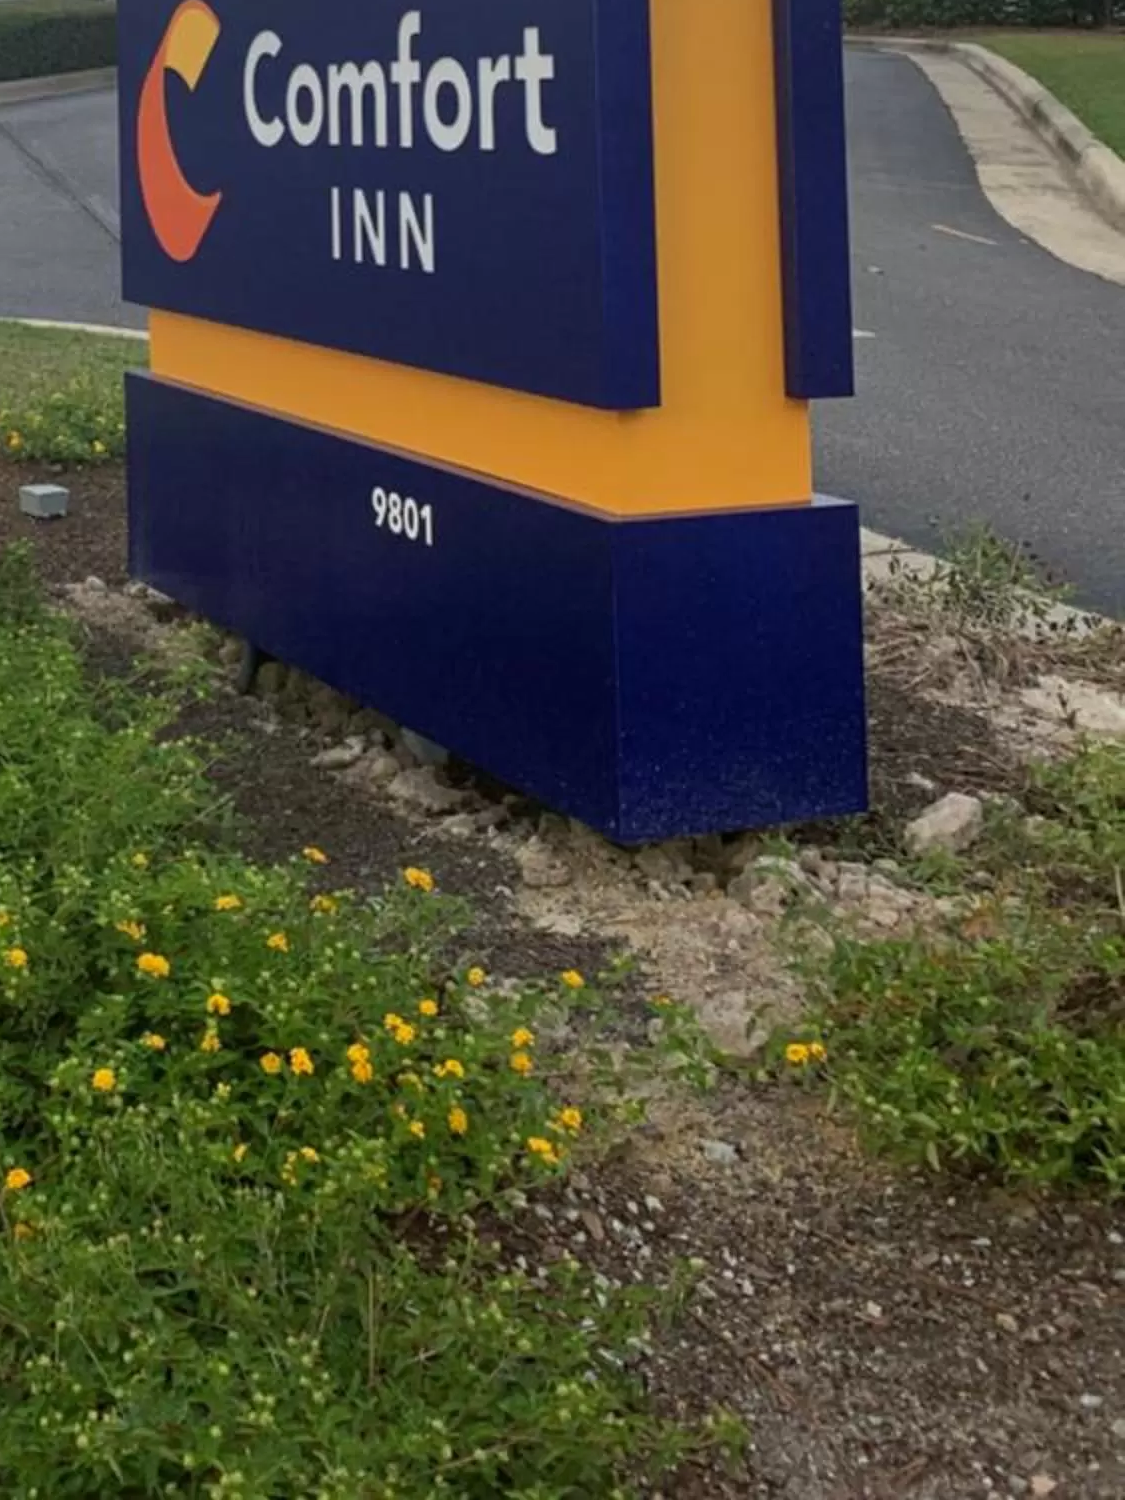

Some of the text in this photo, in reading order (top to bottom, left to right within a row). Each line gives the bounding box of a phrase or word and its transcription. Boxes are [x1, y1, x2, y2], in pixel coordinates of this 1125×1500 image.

[243, 10, 557, 155] Comfort
[330, 186, 435, 274] INN
[371, 485, 433, 546] 9801
